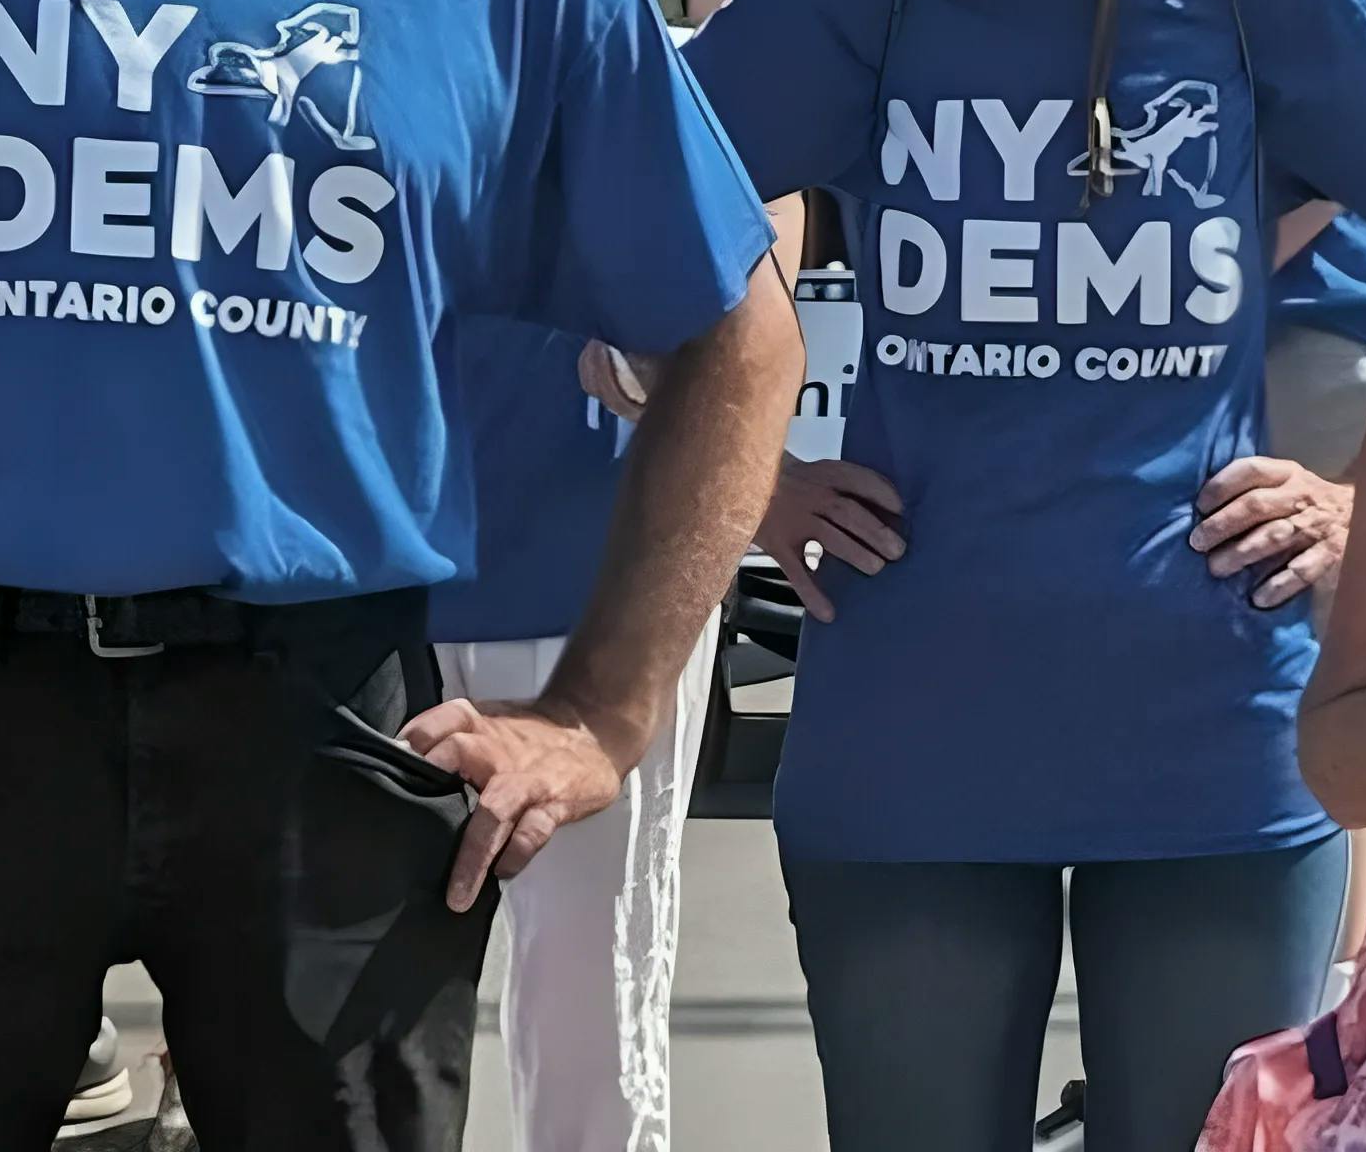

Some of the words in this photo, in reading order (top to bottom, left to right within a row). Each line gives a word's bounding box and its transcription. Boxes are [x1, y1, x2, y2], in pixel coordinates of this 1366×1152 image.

[881, 98, 1073, 201] NY
[879, 208, 1243, 326] DEMS
[190, 289, 368, 348] COUNTY
[876, 334, 1061, 380] ONTARIO
